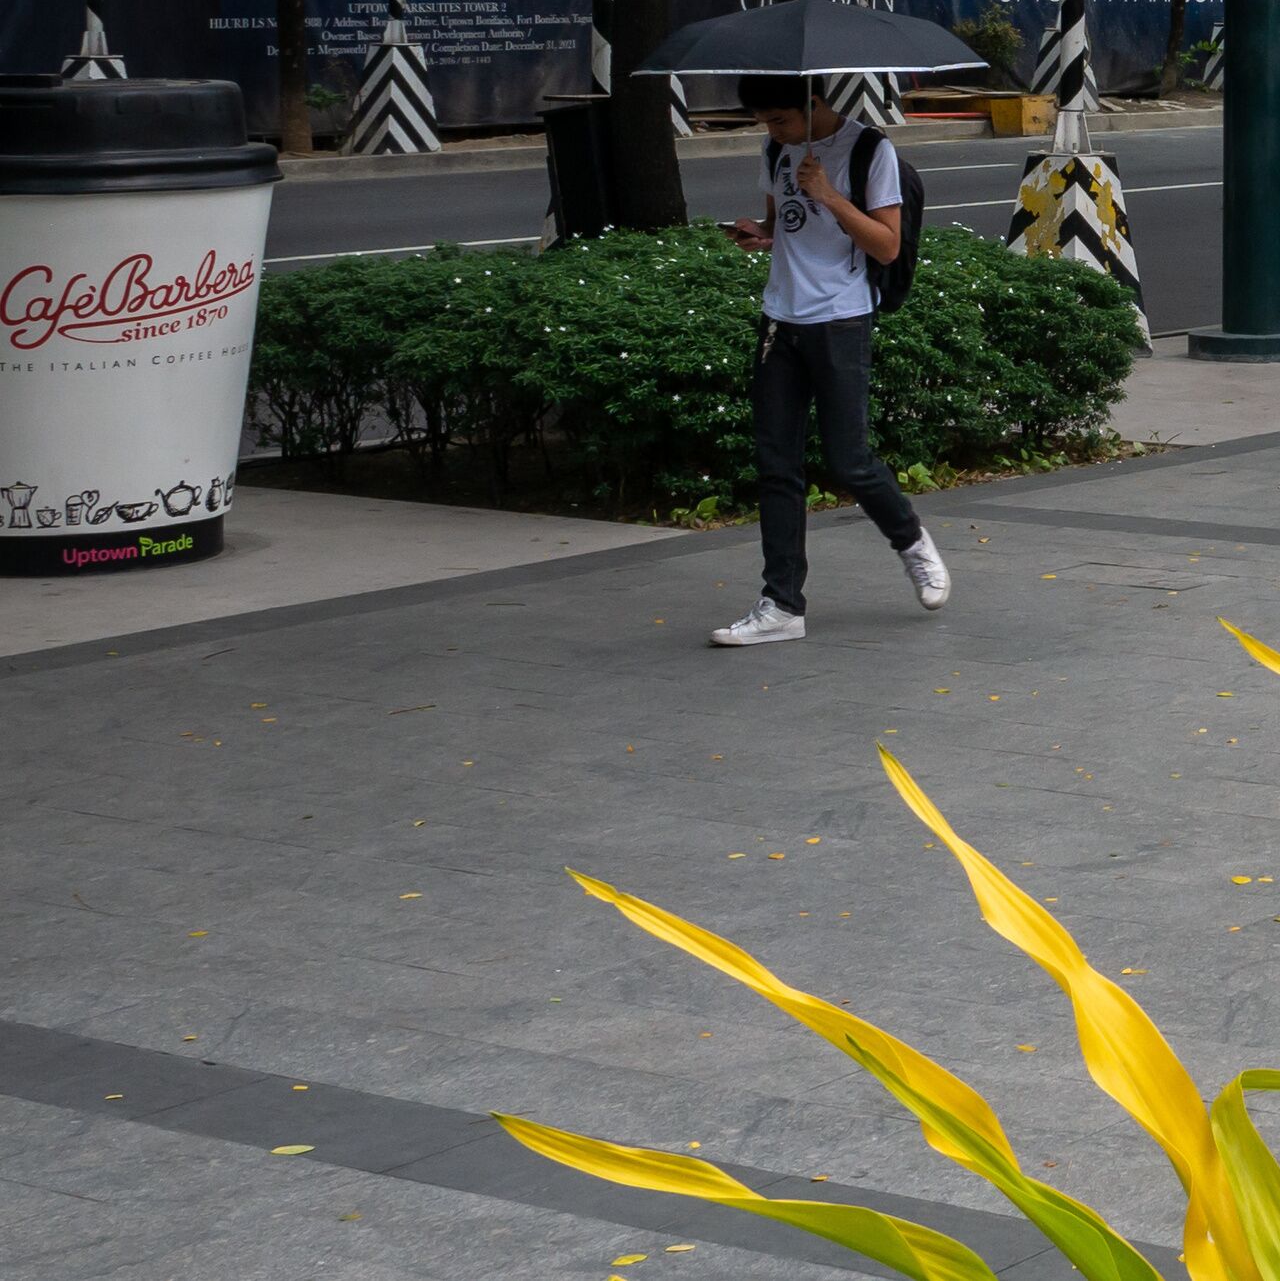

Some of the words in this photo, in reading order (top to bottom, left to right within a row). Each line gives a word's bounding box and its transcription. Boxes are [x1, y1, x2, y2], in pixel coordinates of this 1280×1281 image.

[348, 2, 390, 14] UPTOW
[403, 2, 462, 14] ARKSUITES
[463, 2, 500, 13] TOWER
[501, 2, 507, 13] 2
[209, 17, 250, 29] HLURB
[251, 17, 266, 29] LS
[441, 15, 474, 29] Uptown
[516, 14, 533, 25] Fort
[571, 13, 592, 26] Tagui
[357, 30, 382, 41] Bases
[432, 29, 487, 42] Development
[487, 28, 525, 41] Authority
[318, 44, 367, 57] Megaworld
[431, 41, 481, 55] Completion
[505, 40, 545, 51] December
[97, 249, 255, 317] Barbera
[119, 320, 181, 343] since
[187, 304, 229, 330] 1870
[0, 362, 34, 373] THE
[50, 358, 137, 373] ITALIAN
[151, 350, 213, 366] COFFEE
[63, 545, 138, 568] Uptown
[139, 533, 194, 558] Parade
